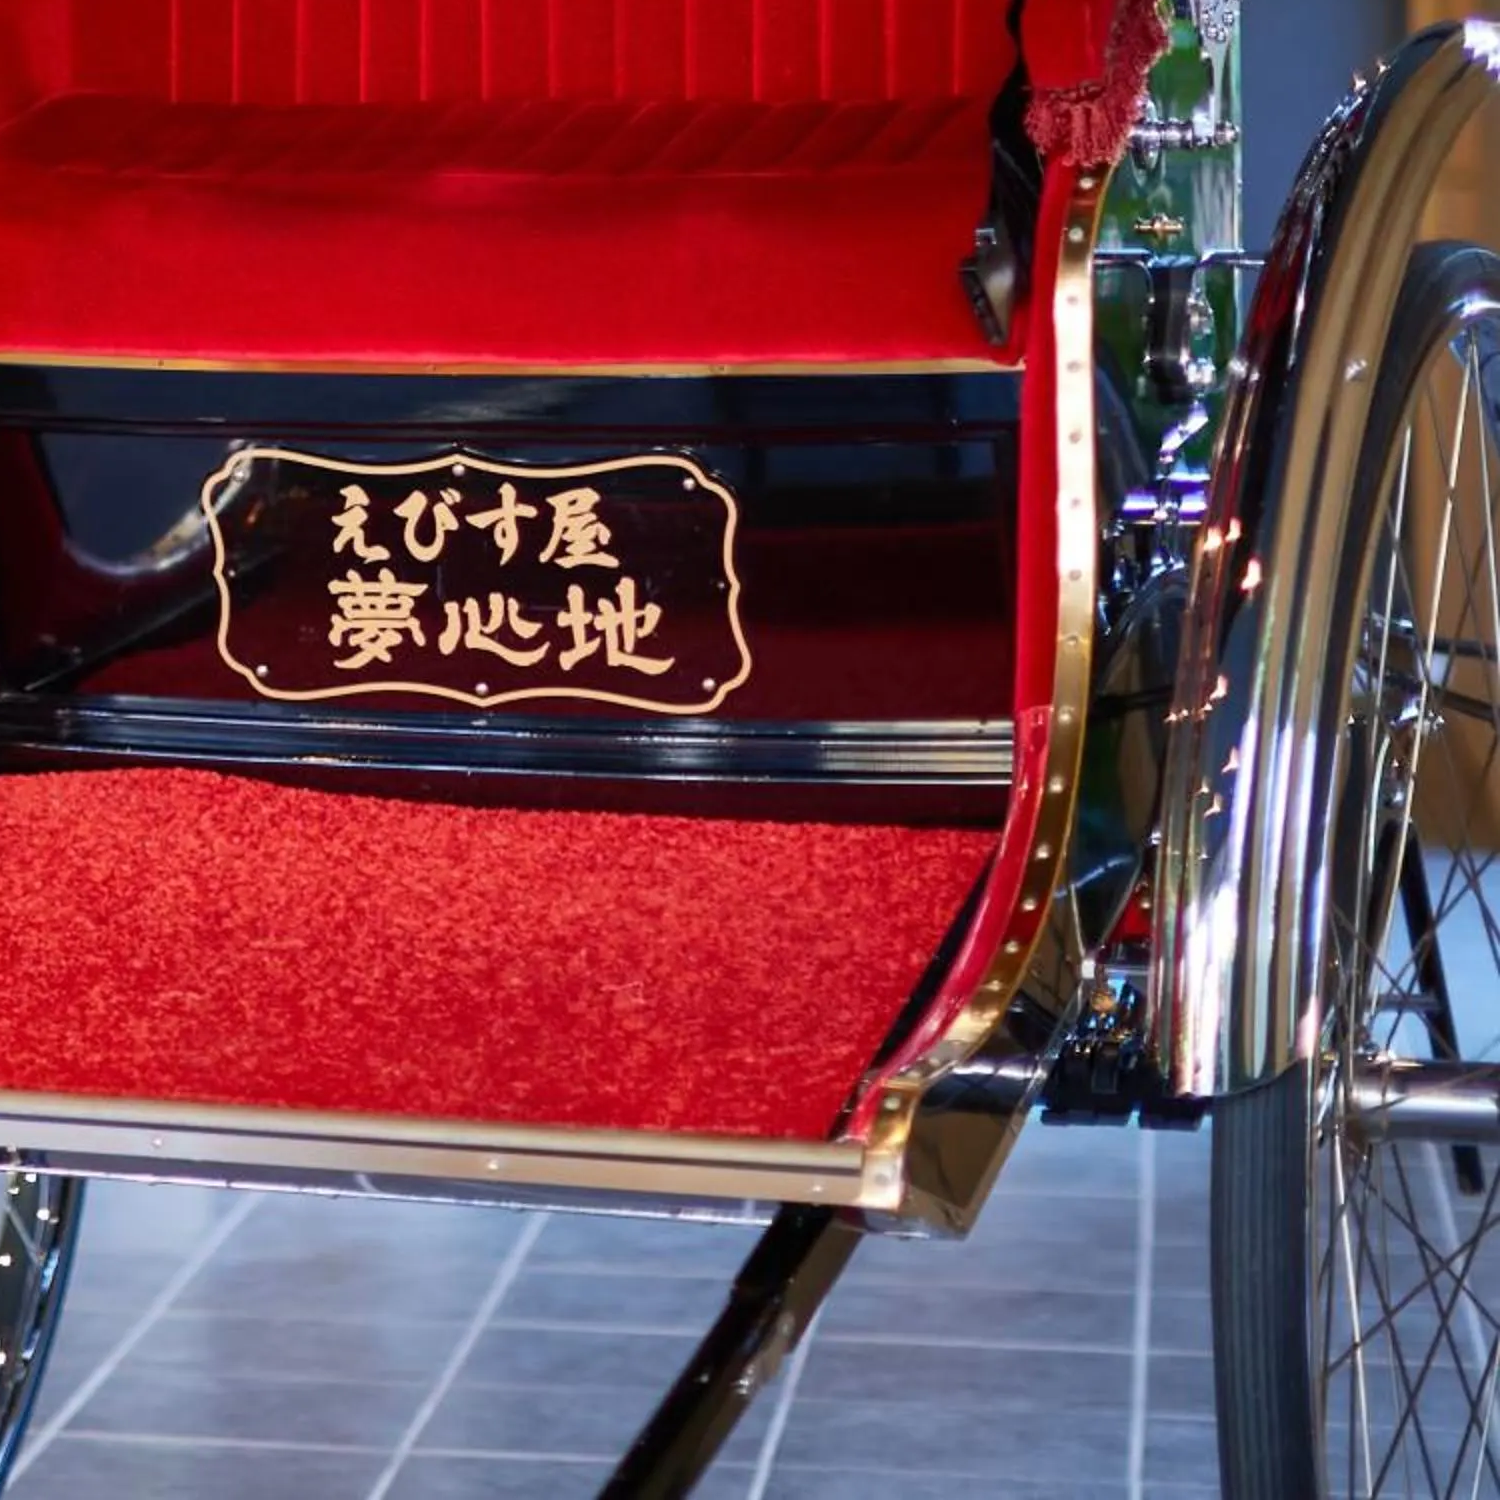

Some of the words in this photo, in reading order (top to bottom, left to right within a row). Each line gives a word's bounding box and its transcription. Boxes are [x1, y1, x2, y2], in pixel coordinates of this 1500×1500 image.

[331, 483, 619, 568] えびす屋
[328, 569, 675, 675] 夢心地
